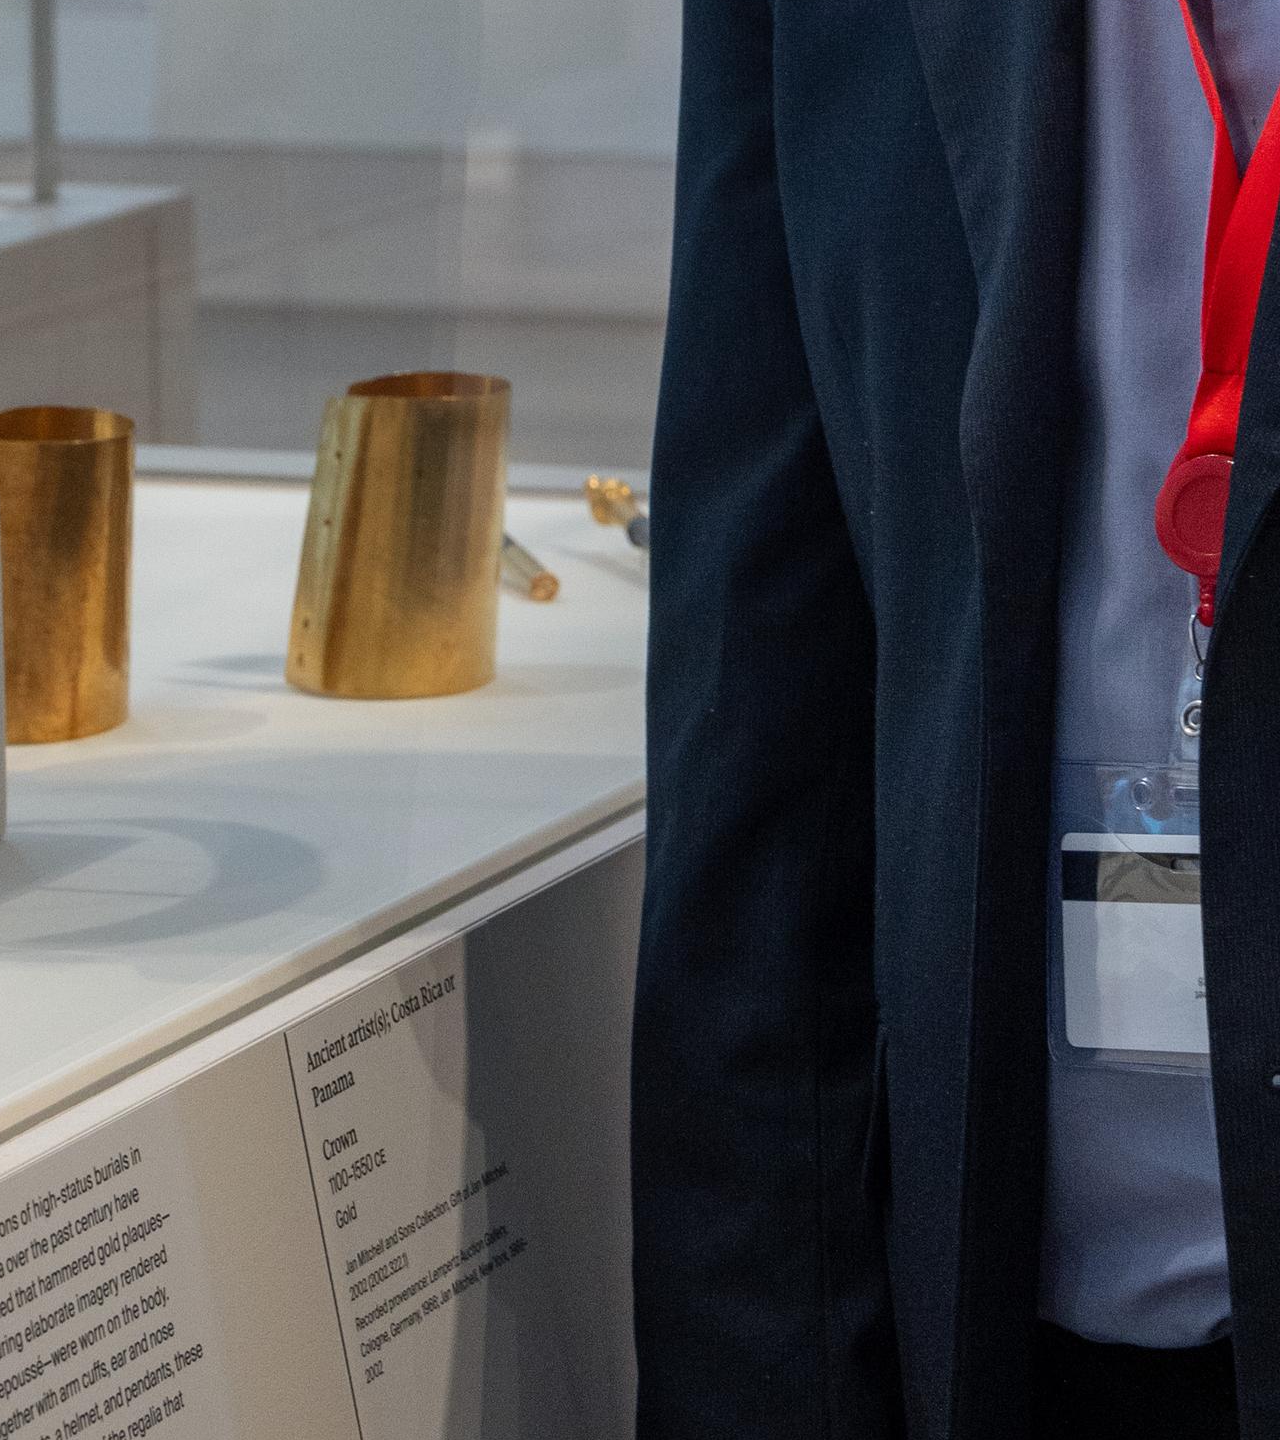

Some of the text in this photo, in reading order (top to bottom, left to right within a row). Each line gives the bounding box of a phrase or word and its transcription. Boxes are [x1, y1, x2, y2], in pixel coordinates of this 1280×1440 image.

[306, 974, 455, 1073] Ancient artist(s); Costa Rica or
[310, 1070, 355, 1107] Panama
[322, 1127, 358, 1161] Crown
[373, 1147, 387, 1167] CE
[19, 1201, 31, 1225] of
[31, 1173, 93, 1218] high-status
[92, 1152, 130, 1185] burials
[129, 1146, 141, 1165] in
[335, 1200, 357, 1229] Gold
[5, 1247, 29, 1273] over
[29, 1237, 49, 1259] the
[49, 1220, 74, 1253] past
[74, 1201, 113, 1235] century
[113, 1187, 139, 1213] have
[14, 1280, 38, 1308] that
[37, 1245, 96, 1295] hammered
[96, 1231, 121, 1266] gold
[24, 1301, 75, 1343] elaborate
[75, 1275, 118, 1313] imagery
[119, 1243, 167, 1287] rendered
[77, 1323, 106, 1350] worn
[106, 1314, 121, 1334] on
[120, 1303, 140, 1325] the
[139, 1285, 169, 1314] body.
[34, 1388, 58, 1416] with
[58, 1377, 81, 1403] arm
[81, 1359, 111, 1389] cuffs,
[110, 1348, 127, 1371] ear
[128, 1331, 149, 1361] and
[148, 1321, 174, 1348] nose
[62, 1402, 103, 1440] helmet,
[102, 1386, 124, 1416] and
[123, 1361, 175, 1407] pendants,
[173, 1342, 203, 1372] these
[127, 1405, 163, 1440] regalia
[162, 1390, 185, 1417] that
